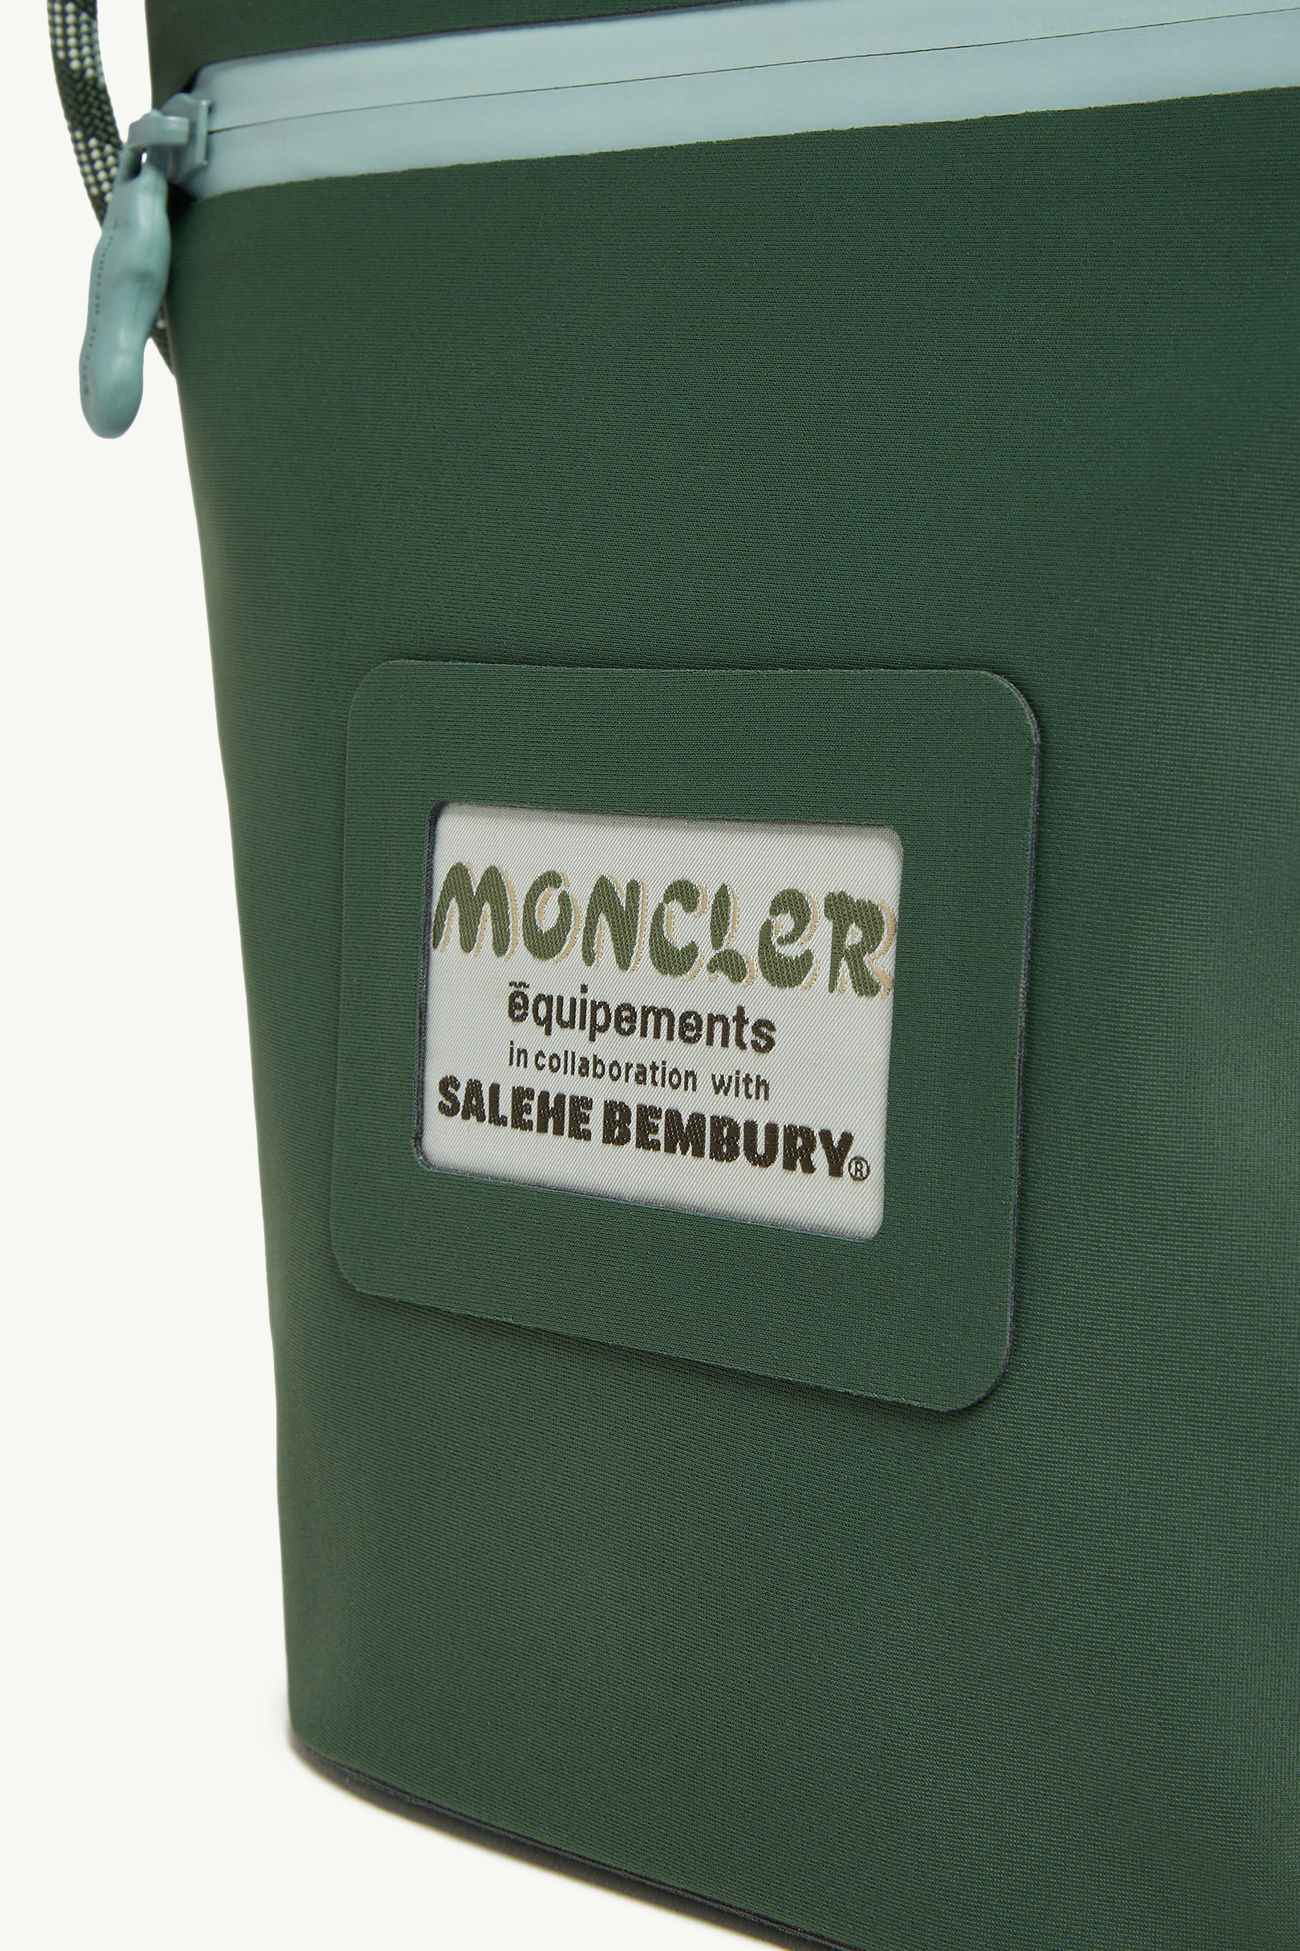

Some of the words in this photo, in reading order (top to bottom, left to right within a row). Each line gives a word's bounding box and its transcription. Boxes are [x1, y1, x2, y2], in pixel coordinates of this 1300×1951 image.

[432, 862, 898, 998] MONCLER
[508, 1040, 528, 1069] in
[533, 1050, 698, 1093] collaboration
[711, 1071, 770, 1101] with
[437, 1075, 593, 1141] SALEHE
